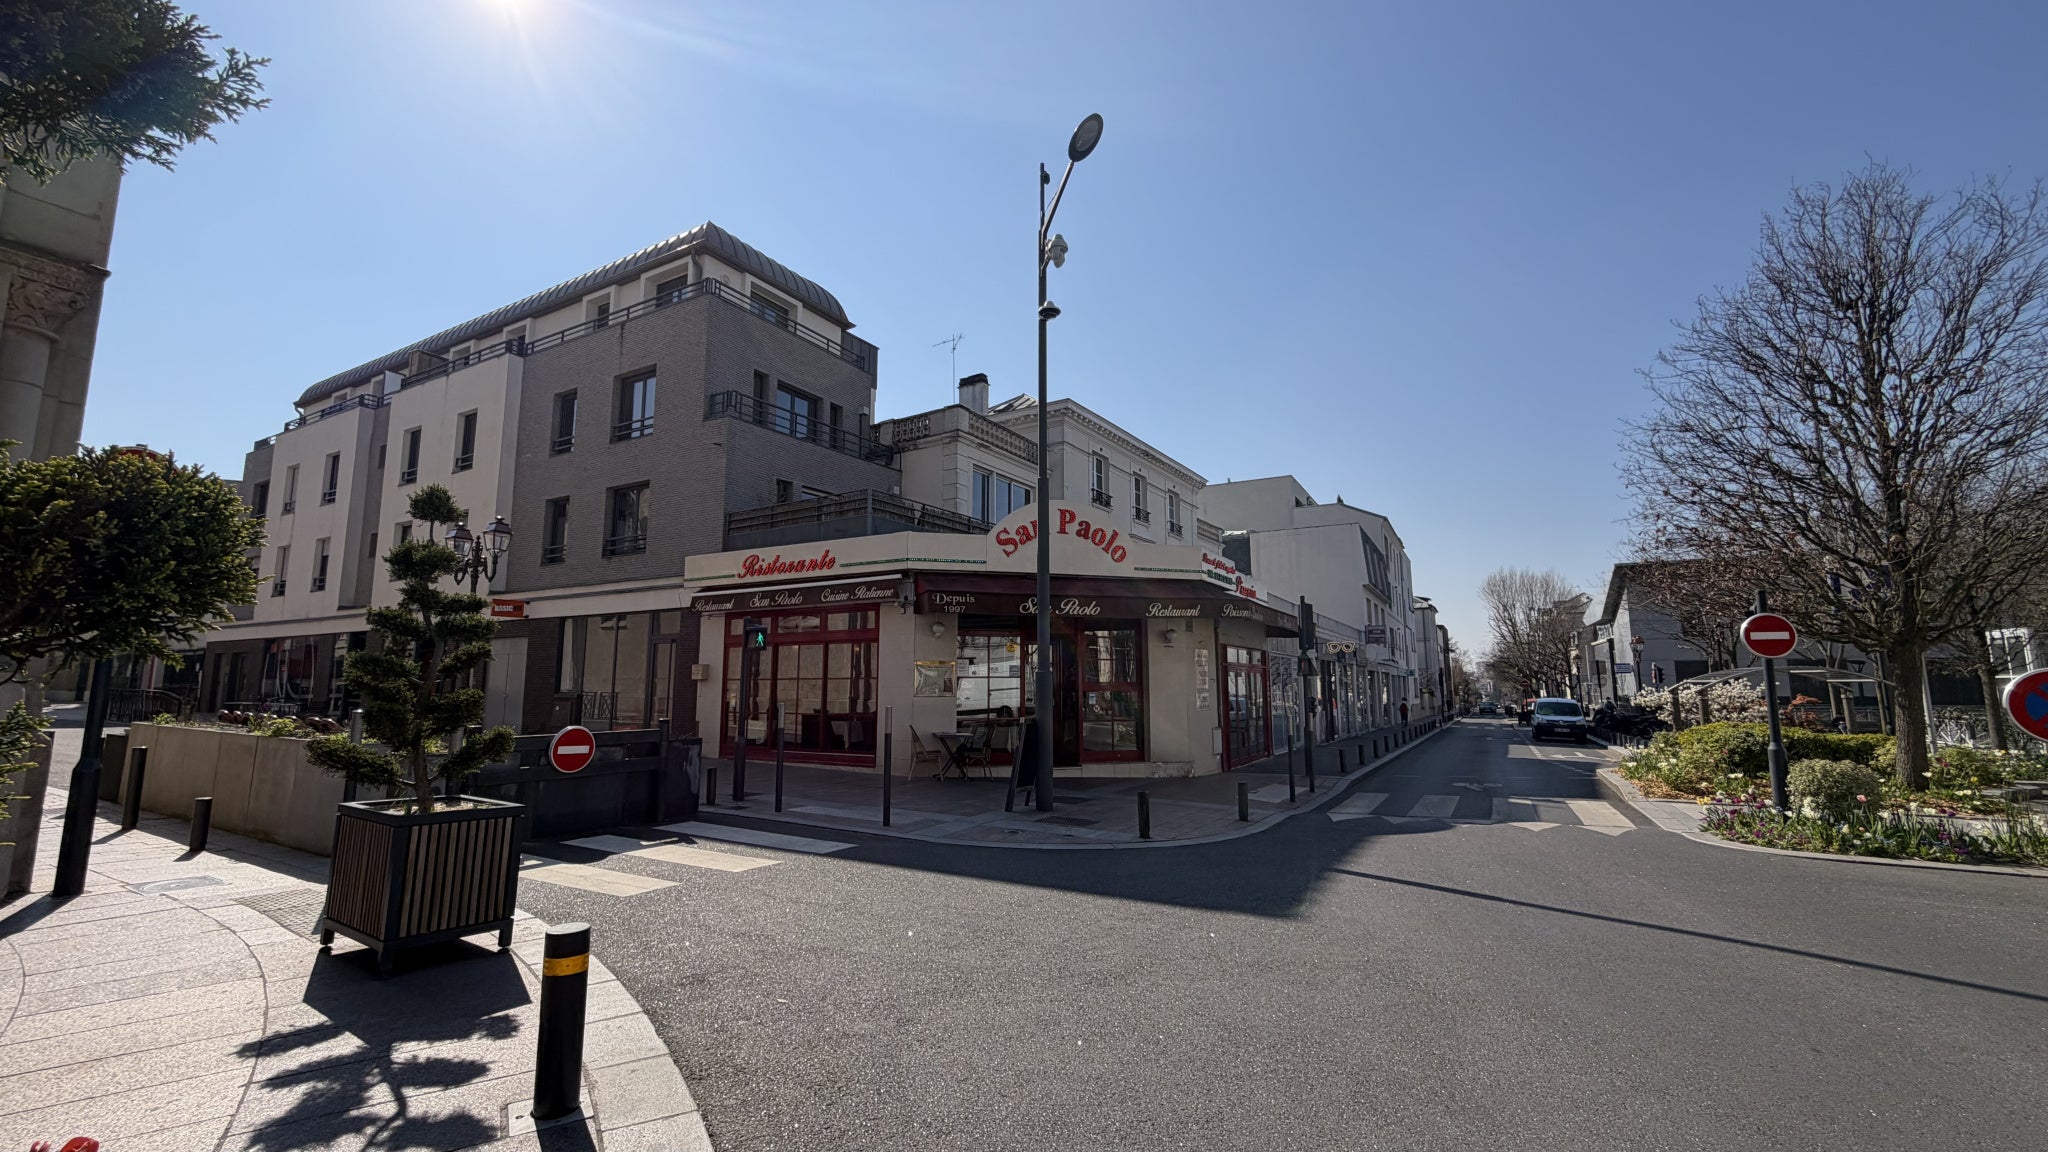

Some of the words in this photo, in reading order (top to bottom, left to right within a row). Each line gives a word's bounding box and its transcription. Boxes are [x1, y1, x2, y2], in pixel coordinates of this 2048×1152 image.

[1056, 508, 1127, 563] Paolo
[737, 549, 836, 579] Ristorante
[692, 598, 735, 612] Restaurant
[750, 593, 770, 607] San
[773, 591, 803, 606] Paolo
[821, 588, 850, 602] Cuisine
[851, 585, 894, 599] Italienne
[932, 593, 976, 605] Depuis
[1055, 598, 1101, 616] Paolo
[944, 605, 966, 613] 1997
[1146, 602, 1201, 617] Restaurant
